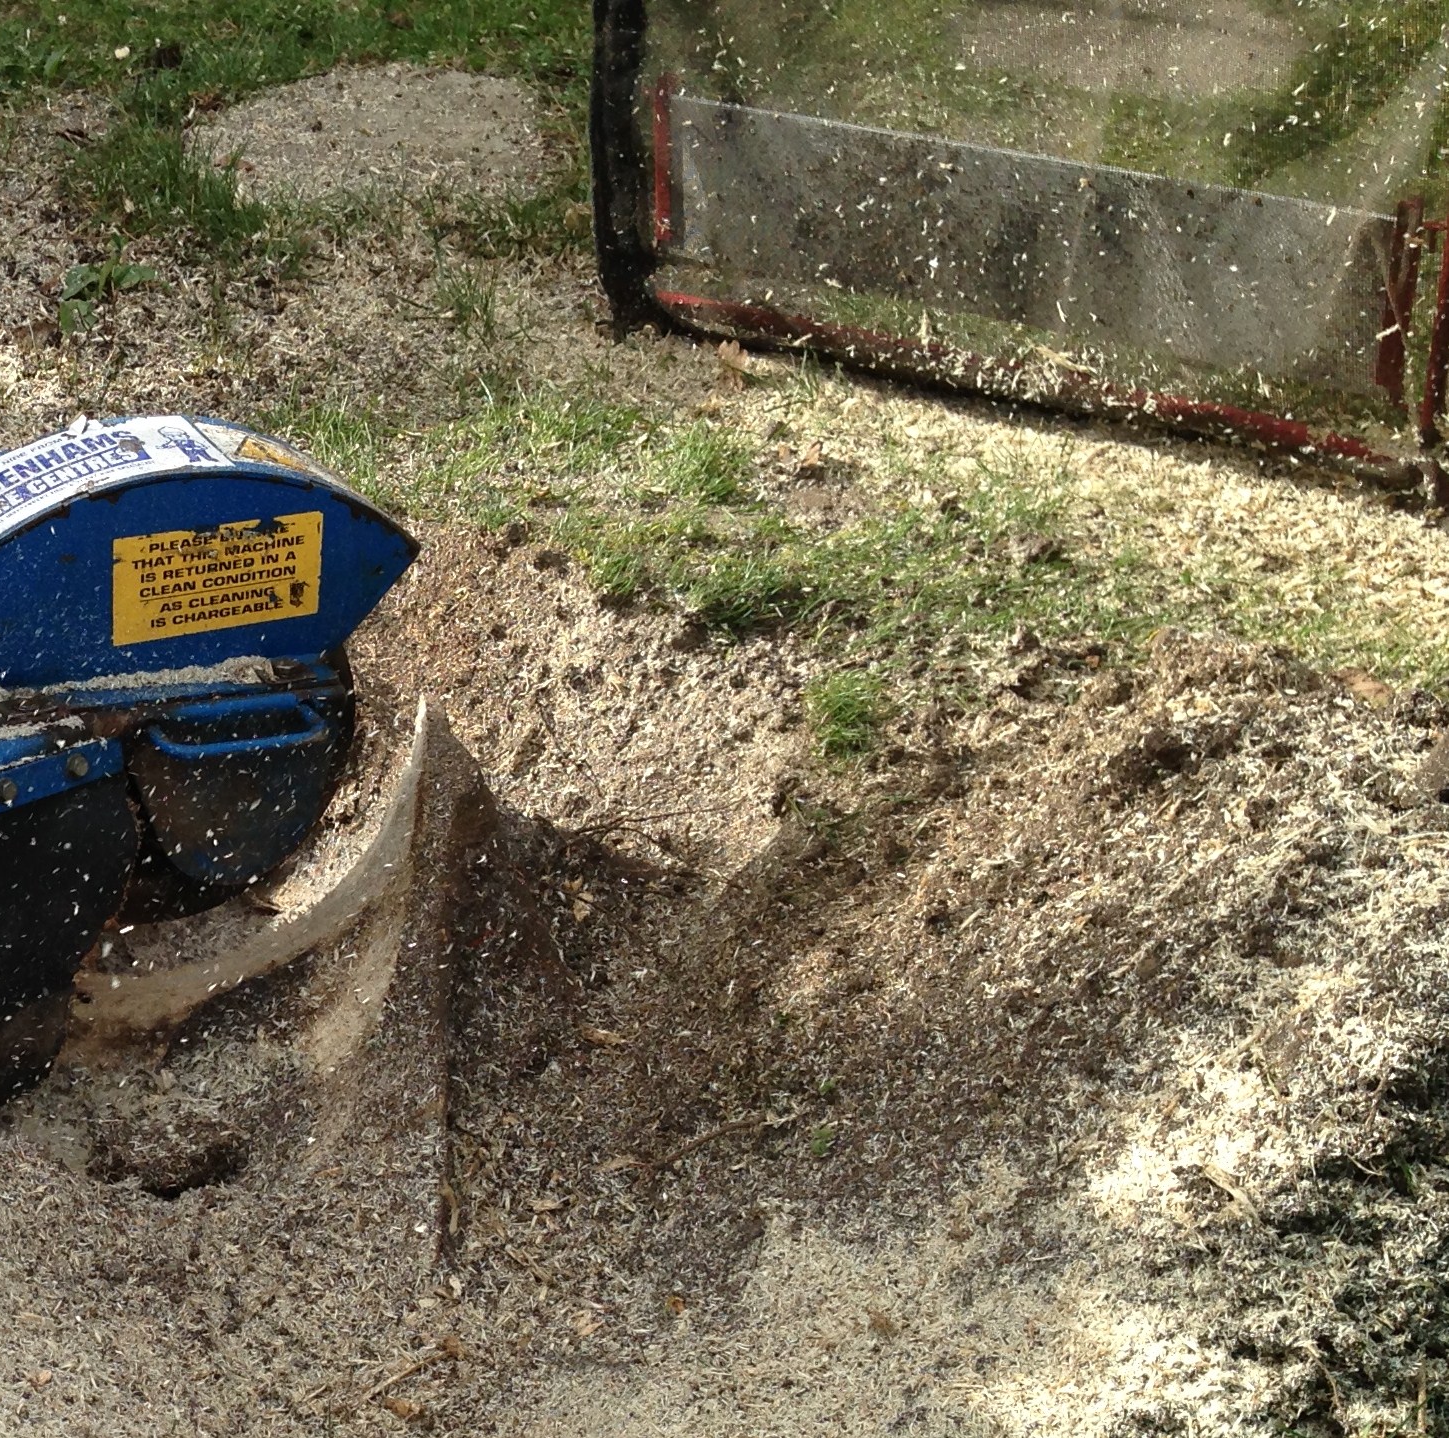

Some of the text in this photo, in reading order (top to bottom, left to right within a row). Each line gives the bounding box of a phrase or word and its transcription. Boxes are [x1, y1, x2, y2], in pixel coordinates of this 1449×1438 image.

[132, 554, 175, 570] THAT
[224, 535, 305, 557] MACHINE
[149, 533, 216, 554] PLEASE
[139, 564, 296, 599] CLEAN CONDITION
[140, 550, 297, 584] IS RETURNED IN A
[150, 599, 283, 629] IS CHARGEABLE
[159, 586, 276, 614] AS CLEANING
